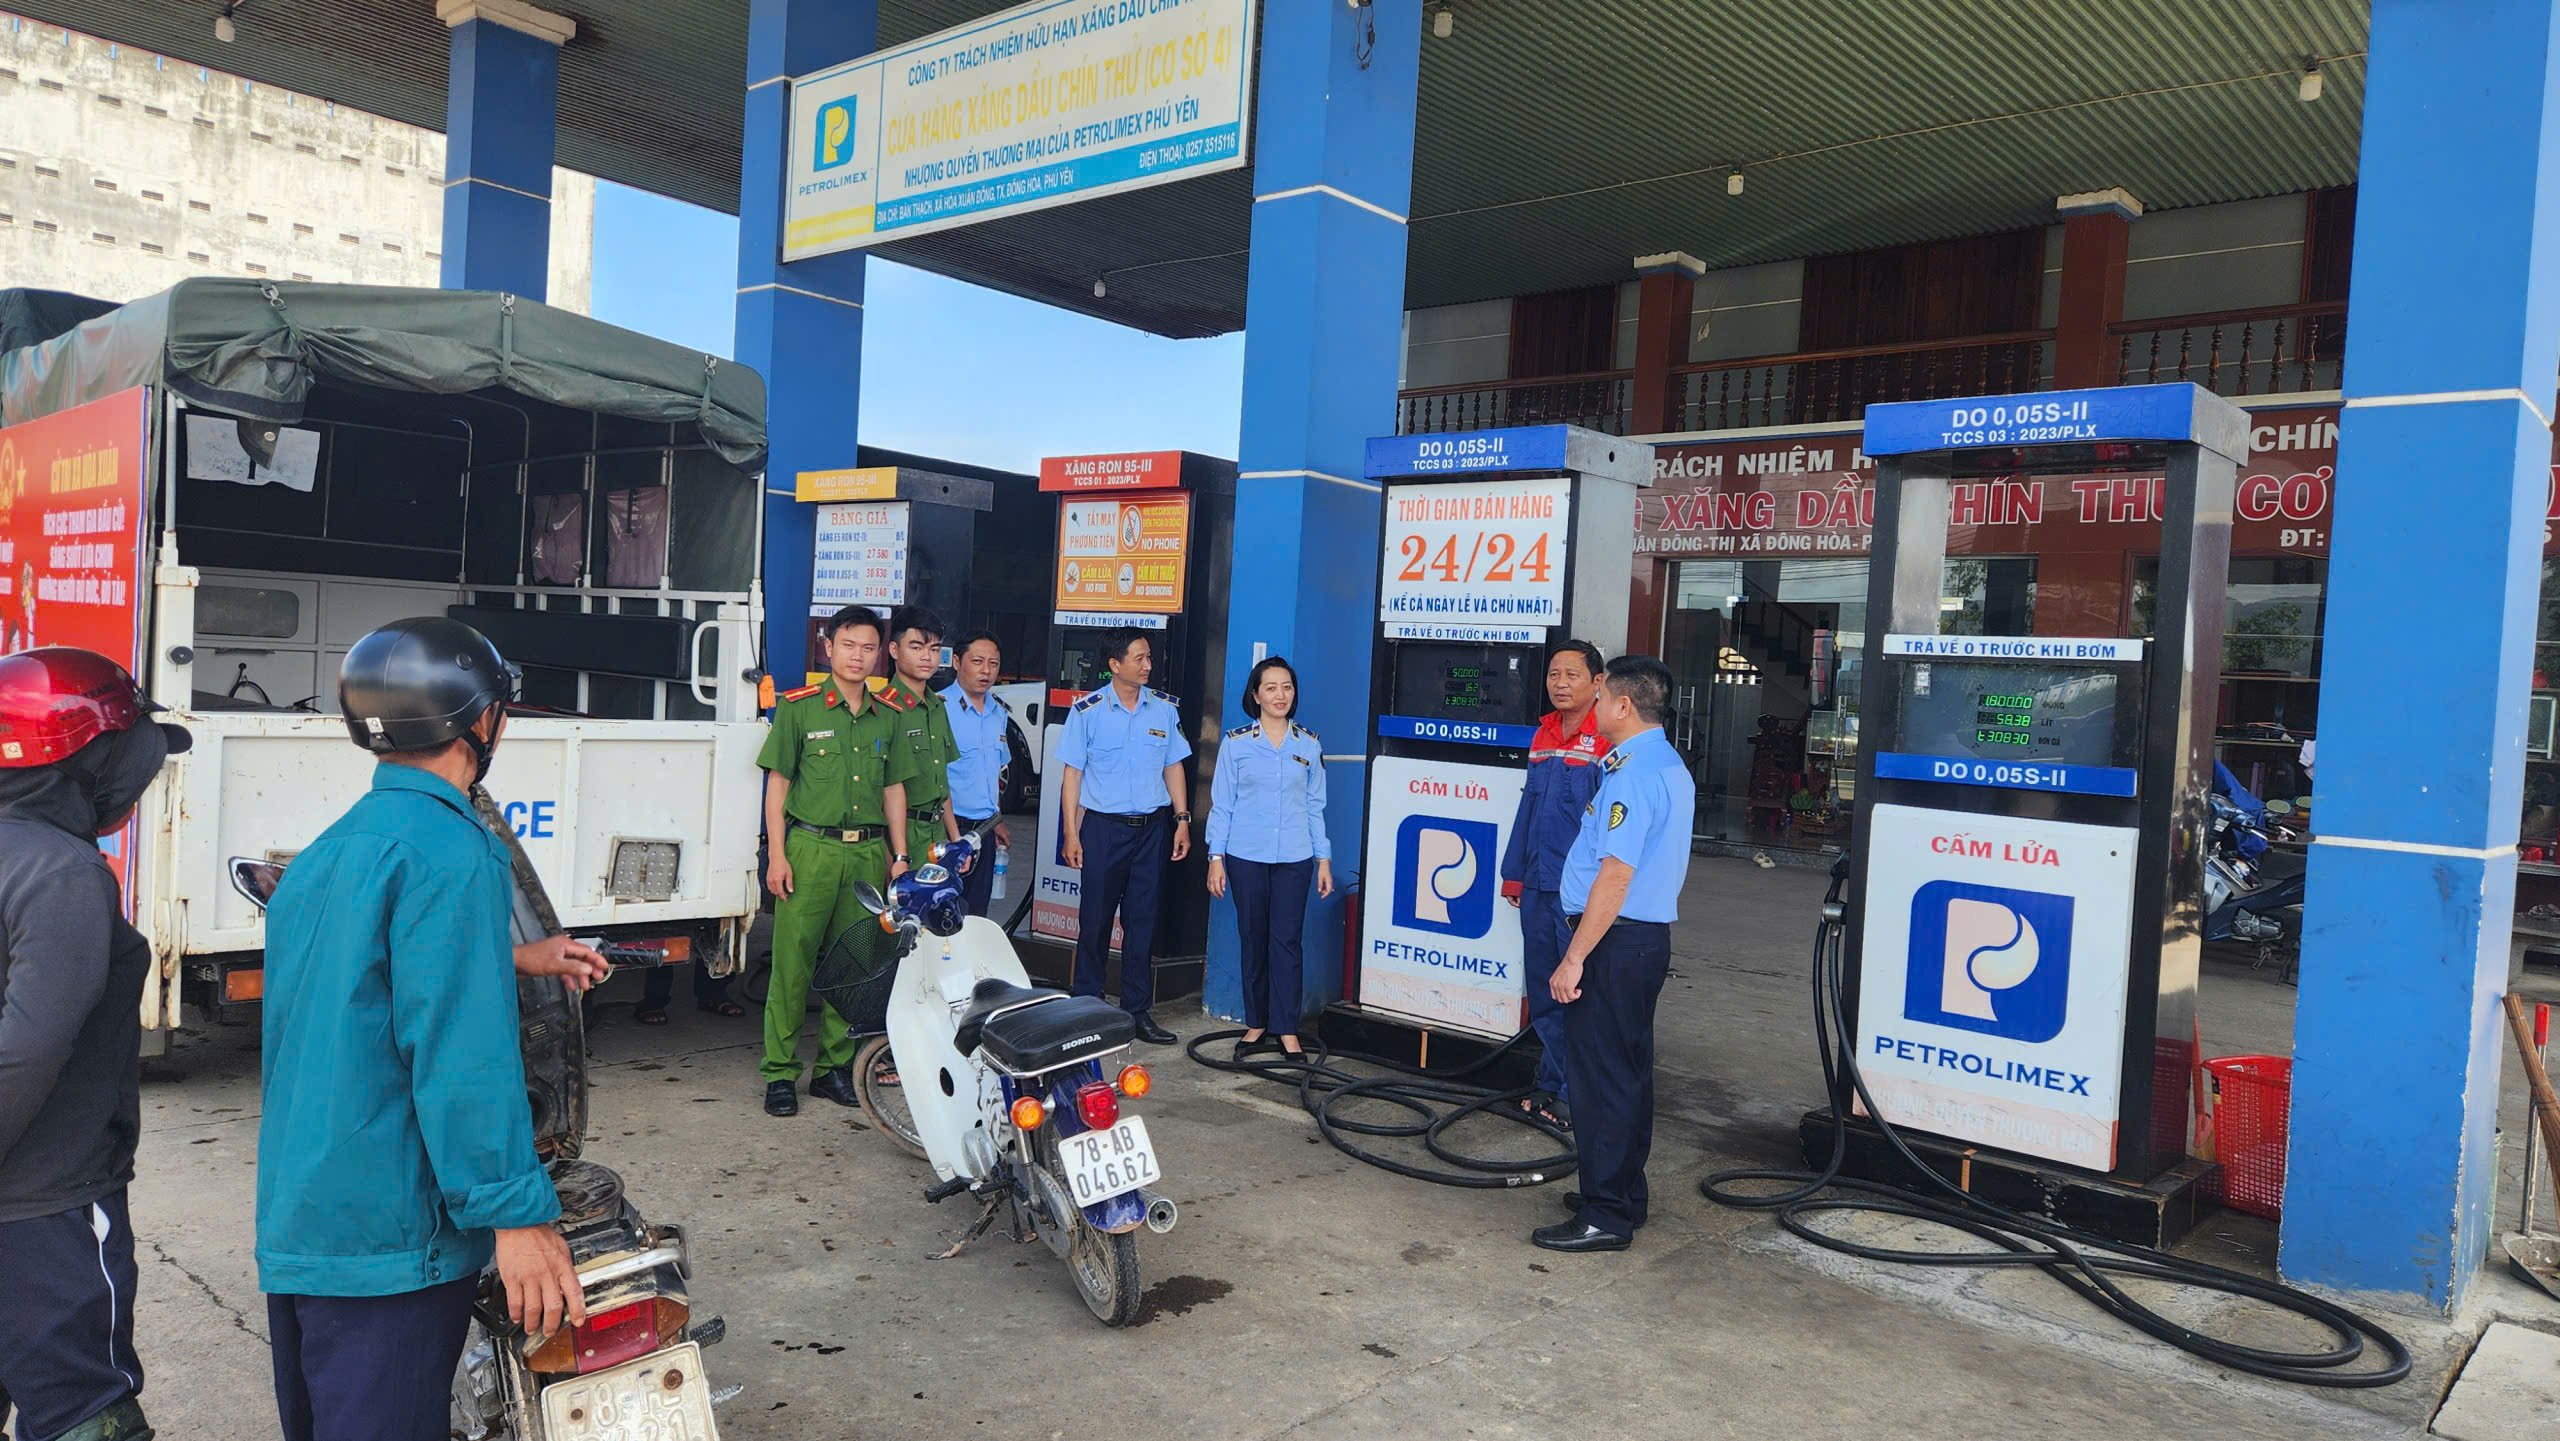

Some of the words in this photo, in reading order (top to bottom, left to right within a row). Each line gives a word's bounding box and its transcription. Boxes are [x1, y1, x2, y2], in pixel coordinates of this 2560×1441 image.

[908, 60, 936, 86] CÔNG
[939, 56, 951, 77] TY
[954, 43, 986, 72] TRÁCH
[989, 31, 1023, 63] NHIỆM
[1026, 23, 1050, 50] HỮU
[1053, 15, 1078, 47] HẠN
[1080, 6, 1115, 35] XĂNG
[968, 82, 1011, 136] XĂNG
[1017, 60, 1052, 124] DẦU
[904, 163, 944, 188] NHƯỢNG
[946, 146, 980, 179] QUYỀN
[982, 143, 1023, 171] THƯƠNG
[1026, 136, 1045, 163] MẠI
[1047, 124, 1070, 155] CỦA
[1073, 112, 1143, 149] PETROLIMEX
[1145, 100, 1171, 132] PHÚ
[1175, 94, 1200, 124] YÊN
[1139, 152, 1158, 171] ĐIỆN
[1185, 140, 1203, 159] 0257
[1204, 132, 1236, 154] 3515116
[799, 171, 868, 196] PETROLIMEX
[1952, 408, 1987, 428] DO
[1993, 401, 2088, 428] 0,05S-II
[1941, 430, 1985, 445] TCCS
[1988, 429, 2007, 442] 03
[2019, 424, 2097, 441] 2023/PLX
[1419, 441, 1442, 457] DO
[1444, 437, 1504, 458] 0,05S-II
[1064, 459, 1096, 476] XĂNG
[1098, 460, 1122, 474] RON
[1124, 458, 1153, 473] 95-III
[1413, 459, 1440, 471] TCCS
[1442, 458, 1453, 469] 03
[1461, 455, 1509, 468] 2023/PLX
[1653, 451, 1724, 479] RÁCH
[1737, 445, 1834, 477] NHIỆM
[1073, 477, 1093, 486] TCCS
[1094, 476, 1102, 485] 01
[1107, 474, 1141, 485] 2023/PLX
[1398, 494, 1431, 522] THỜI
[1434, 498, 1469, 521] GIAN
[1474, 491, 1506, 520] BÁN
[1509, 490, 1553, 519] HÀNG
[1658, 486, 1776, 532] XĂNG
[1949, 477, 2045, 525] HÍN
[2233, 465, 2334, 522] CƠ
[832, 506, 863, 526] BẢNG
[867, 505, 888, 525] GIÁ
[1141, 538, 1155, 549] NO
[1156, 538, 1180, 550] PHONE
[1739, 533, 1761, 551] XÃ
[1766, 534, 1811, 550] ĐÔNG
[2280, 529, 2324, 547] ĐT:
[1398, 531, 1552, 583] 24/24
[1389, 591, 1407, 613] (KỂ
[1409, 592, 1423, 612] CẢ
[1426, 594, 1456, 613] NGÀY
[1458, 592, 1470, 613] LỄ
[1474, 594, 1487, 613] VÀ
[1491, 594, 1513, 614] CHỦ
[1517, 596, 1553, 618] NHẬT)
[1124, 618, 1138, 628] KHI
[1398, 623, 1417, 638] TRẢ
[1420, 624, 1433, 638] VỀ
[1445, 627, 1480, 640] TRƯỚC
[1483, 630, 1501, 641] KHI
[1505, 629, 1530, 641] BƠM
[1904, 637, 1934, 654] TRẢ
[1939, 637, 1959, 654] VỀ
[1980, 640, 2036, 656] TRƯỚC
[2041, 644, 2070, 657] KHI
[2077, 643, 2116, 658] BƠM
[1415, 722, 1436, 736] DO
[1440, 724, 1497, 740] 0,05S-II
[1934, 762, 1968, 779] DO
[1973, 765, 2066, 787] 0,05S-II
[1409, 776, 1448, 797] CẤM
[1455, 779, 1489, 801] LỬA
[496, 800, 555, 838] CE
[1931, 832, 1993, 859] CẤM
[2003, 840, 2060, 867] LỬA
[1042, 877, 1081, 896] PETR
[1373, 939, 1508, 979] PETROLIMEX
[1062, 1034, 1101, 1051] HONDA
[1874, 1035, 2092, 1097] PETROLIMEX
[1073, 1125, 1135, 1167] 78-AB
[1076, 1151, 1153, 1199] 046.62
